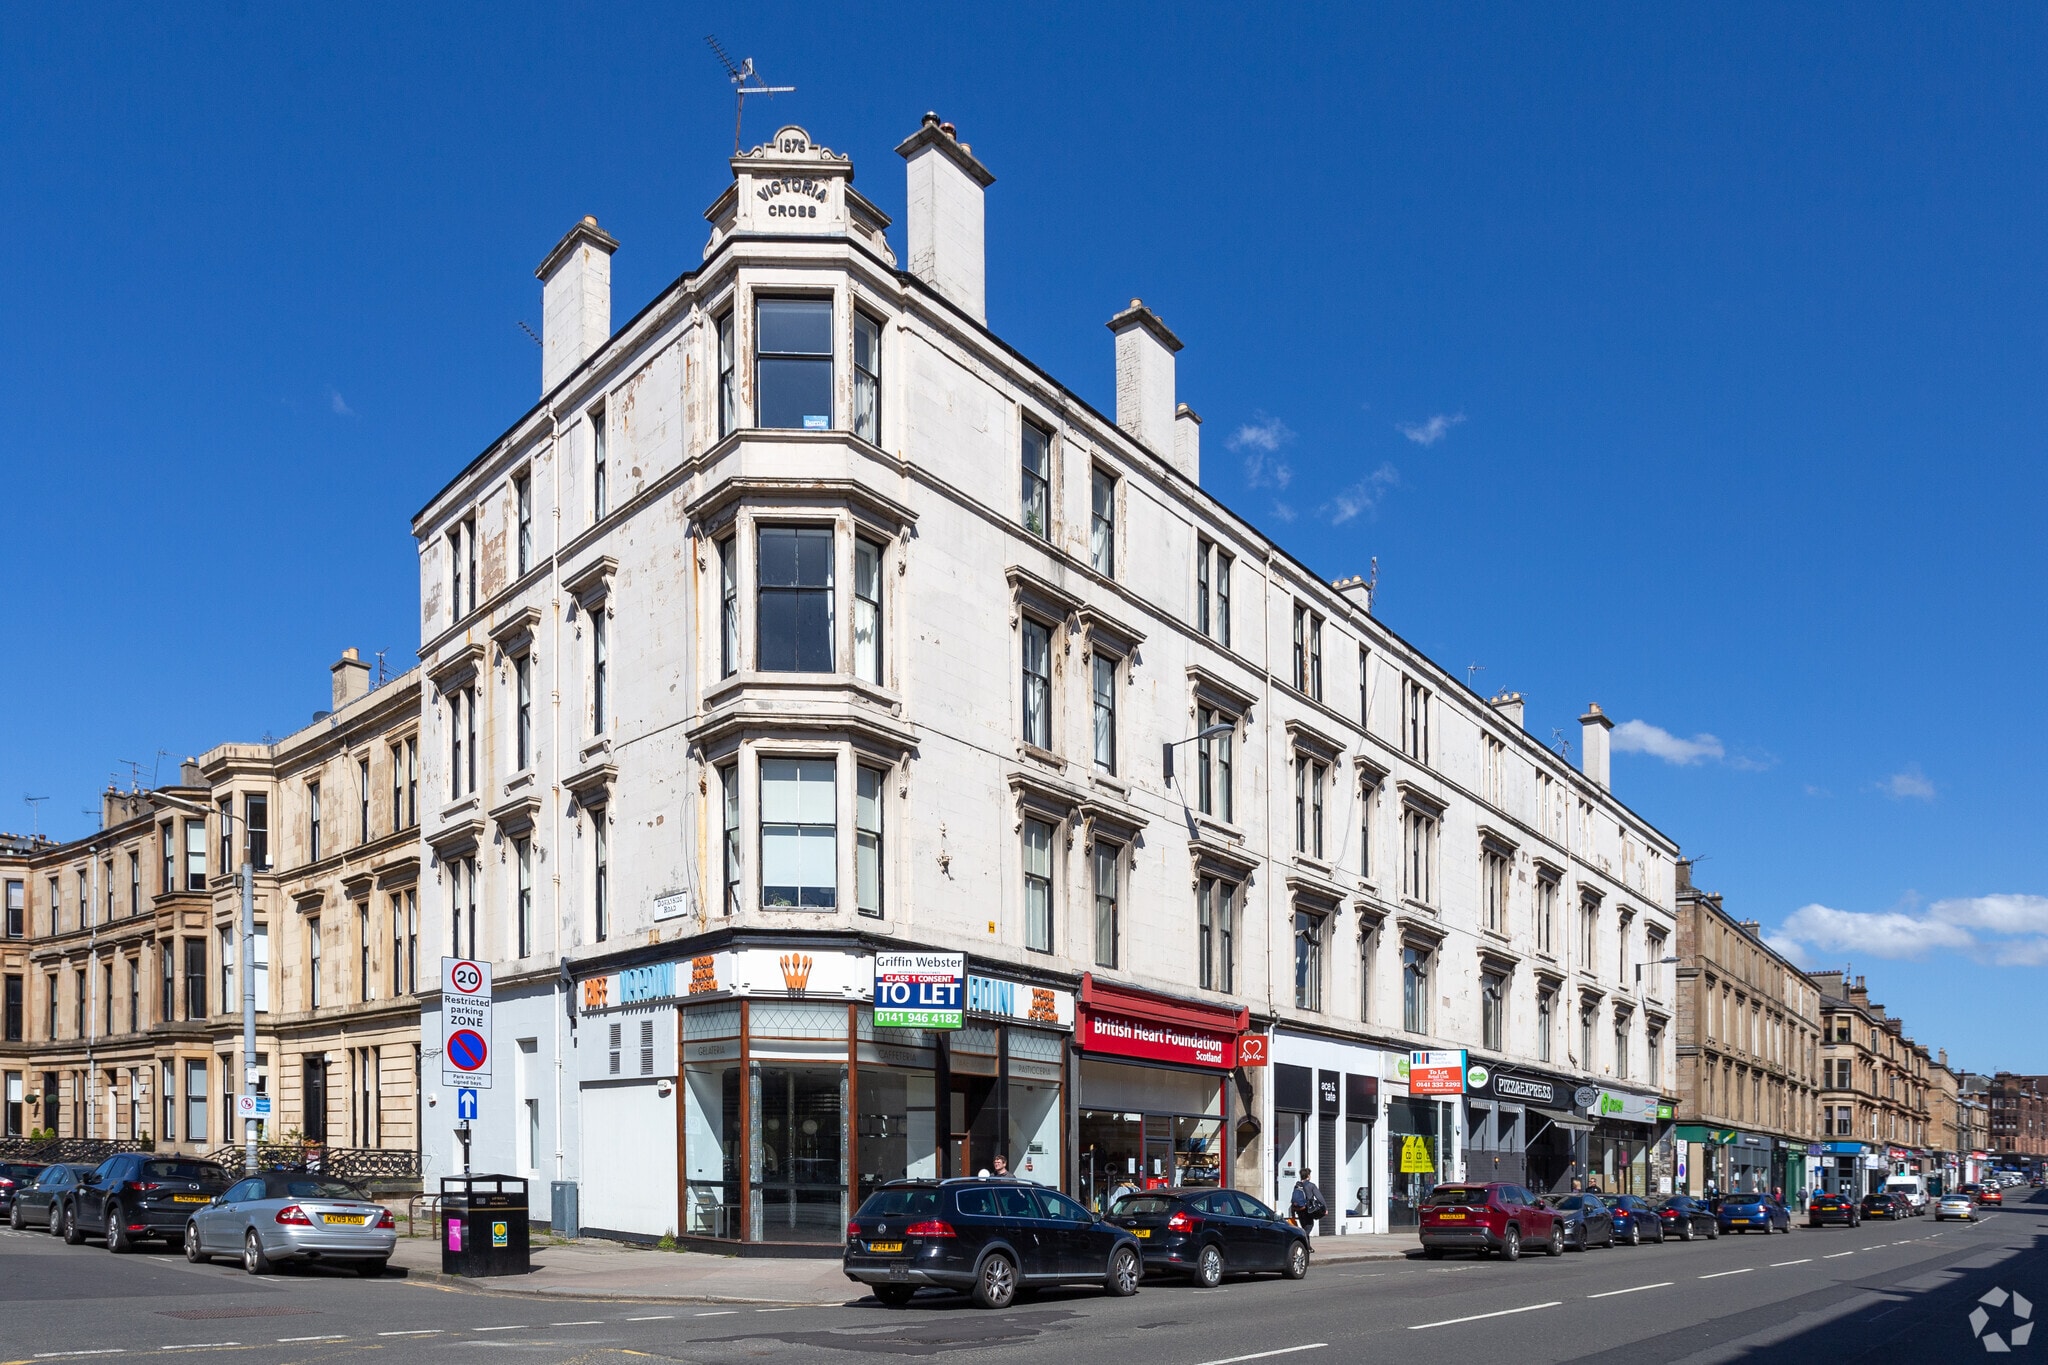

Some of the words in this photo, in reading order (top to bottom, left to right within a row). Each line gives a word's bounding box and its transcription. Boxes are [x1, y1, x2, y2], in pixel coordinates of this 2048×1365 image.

[757, 176, 827, 204] VICTORIA
[768, 205, 817, 218] CROSS
[877, 956, 912, 967] Griffin
[916, 957, 963, 968] Webster
[457, 970, 478, 985] 20
[918, 975, 952, 983] CONSENT
[877, 982, 911, 1004] TO
[920, 983, 960, 1005] LET
[444, 994, 490, 1008] Restricted
[450, 1006, 484, 1018] parking
[877, 1012, 904, 1022] 0141
[908, 1013, 929, 1023] 946
[931, 1013, 959, 1024] 4182
[450, 1015, 484, 1028] ZONE
[1094, 1016, 1132, 1039] British
[1134, 1022, 1164, 1044] Heart
[1165, 1028, 1222, 1052] Foundation
[698, 1045, 726, 1056] GELATERIA
[878, 1049, 917, 1062] CAFFETERIA
[1195, 1050, 1222, 1064] Scotland
[1018, 1063, 1052, 1076] PASTICCERIA
[1321, 1082, 1331, 1090] ace
[1498, 1078, 1551, 1099] PIZZAEXPRESS
[1325, 1091, 1336, 1102] tate
